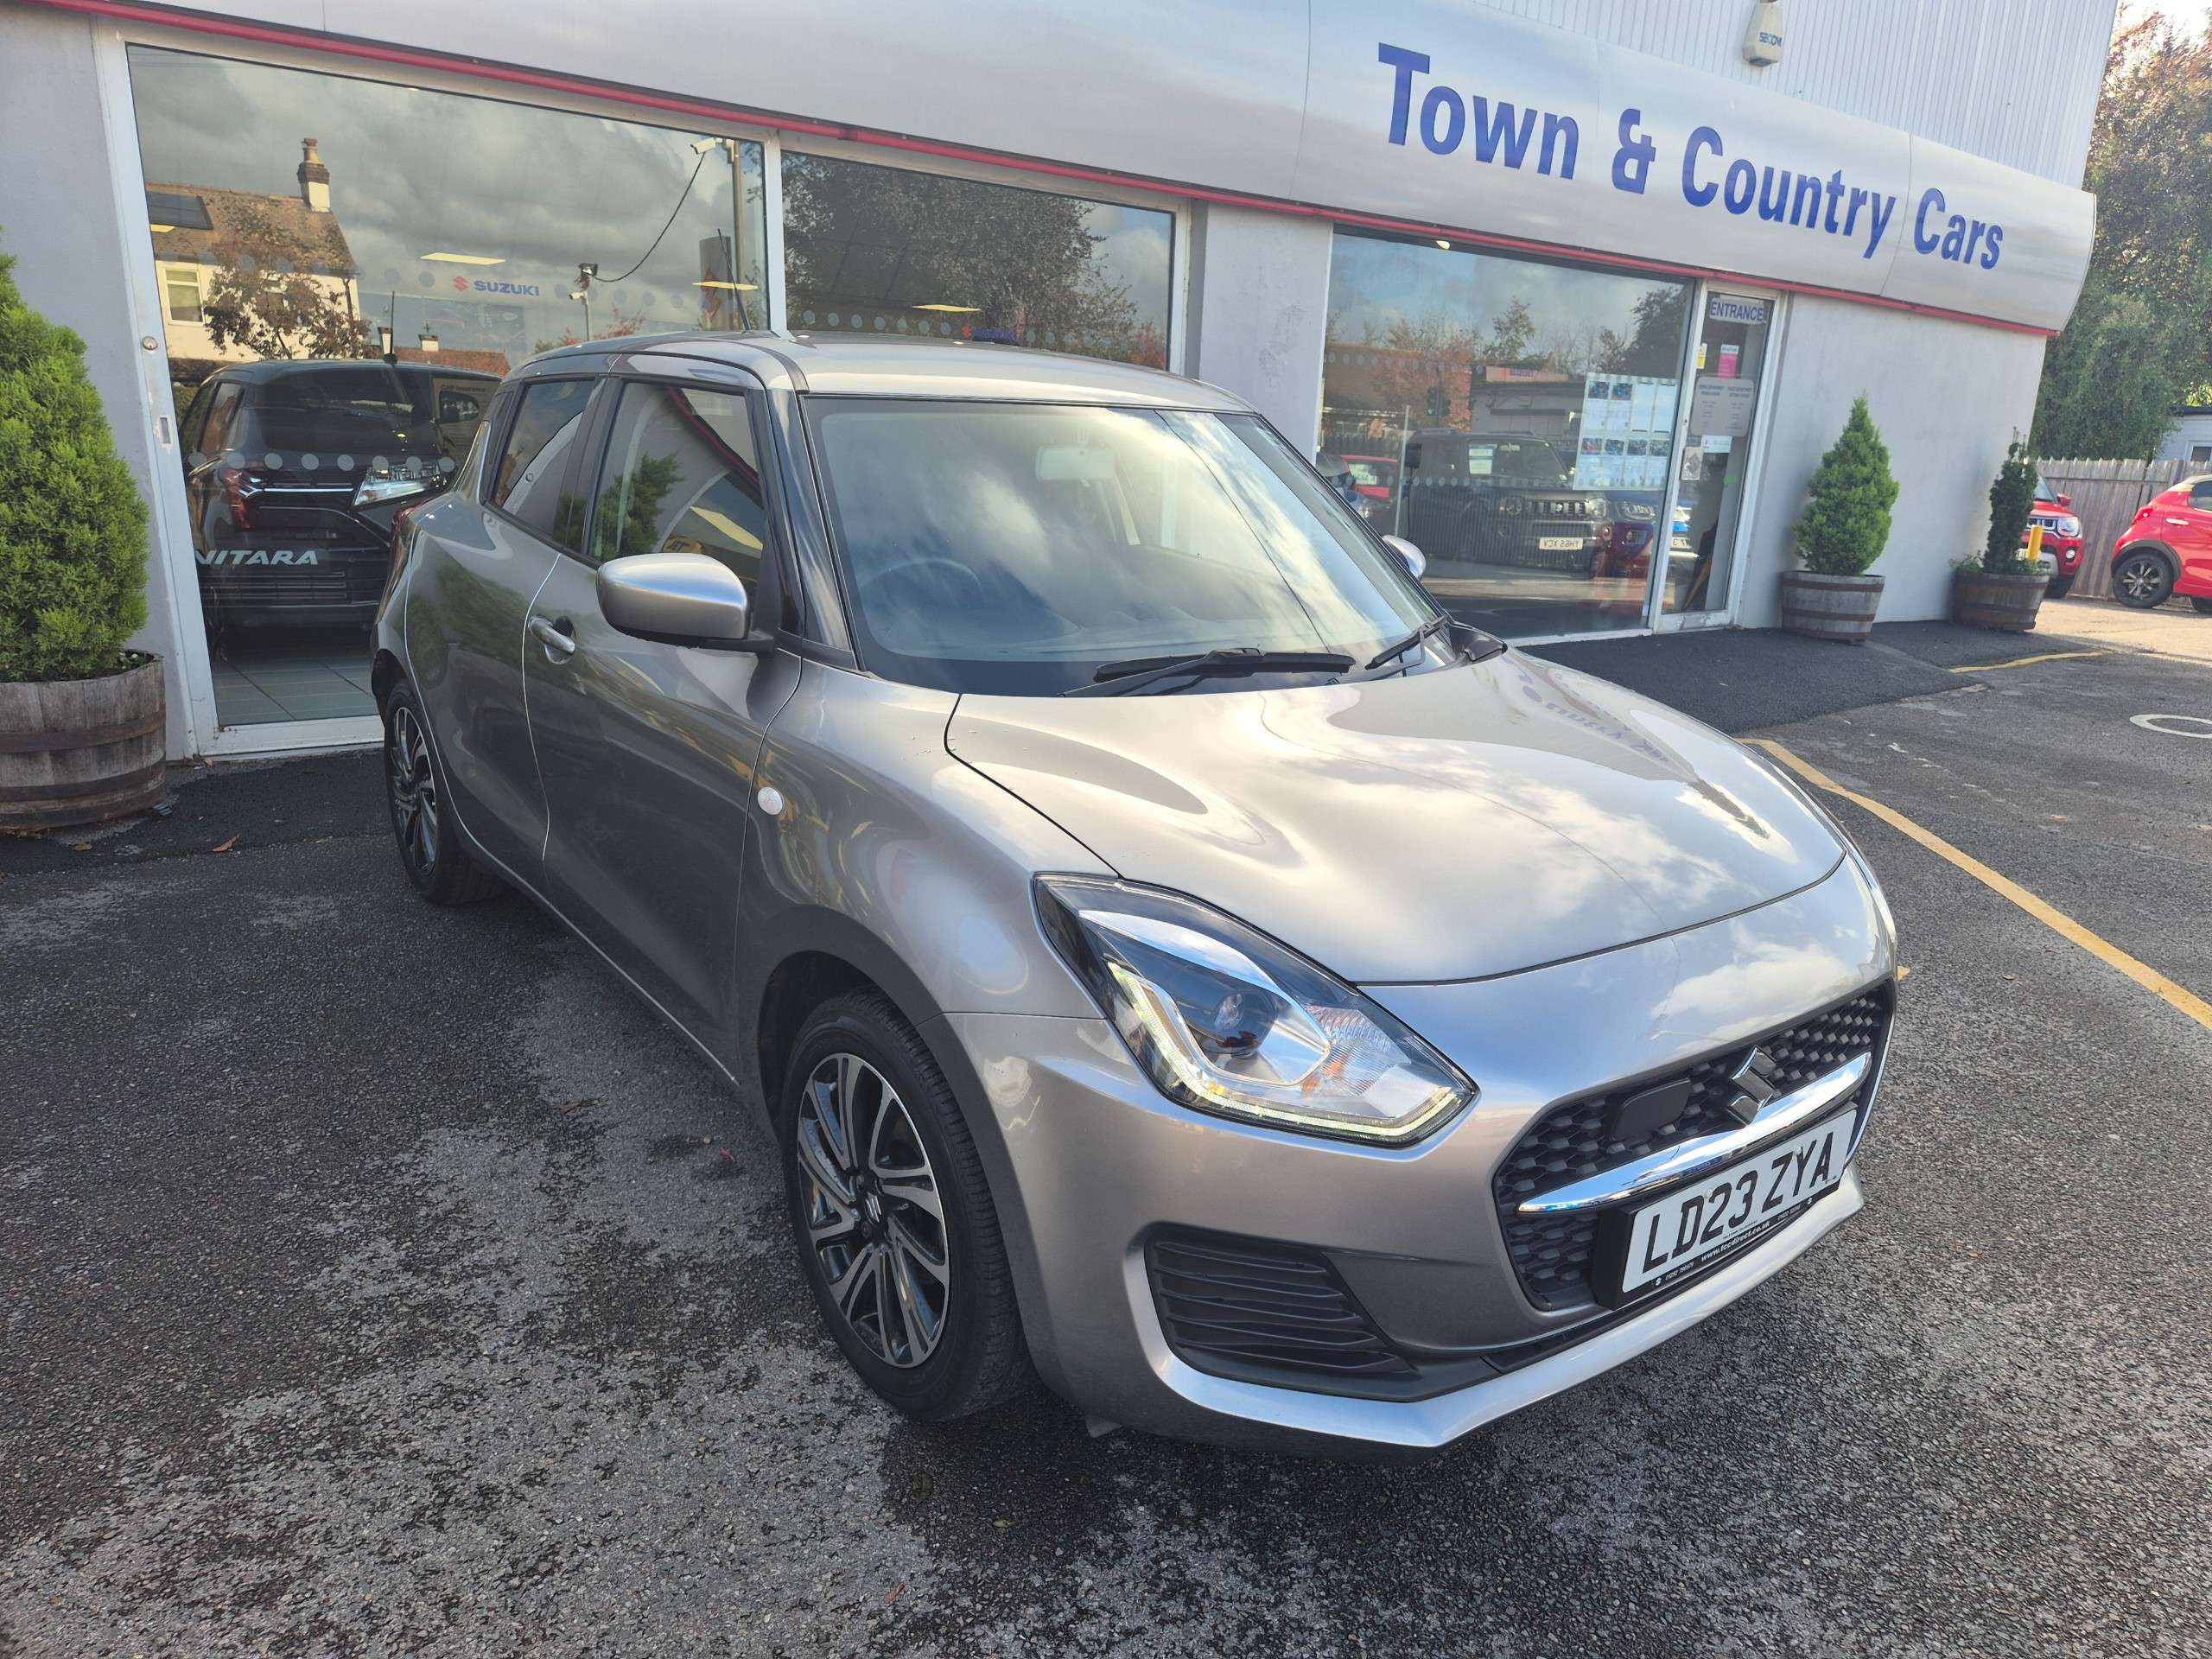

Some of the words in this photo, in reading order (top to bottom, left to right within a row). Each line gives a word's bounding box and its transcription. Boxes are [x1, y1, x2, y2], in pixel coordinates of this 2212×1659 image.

[1378, 42, 1580, 180] Town
[1611, 108, 1656, 194] &
[1681, 126, 1896, 258] Country
[1914, 188, 2004, 270] Cars
[474, 280, 539, 296] SUZUKI
[1710, 301, 1764, 321] ENTRANCE
[195, 550, 319, 565] VITARA
[1642, 1170, 1758, 1274] LD23
[1761, 1131, 1834, 1214] ZYA
